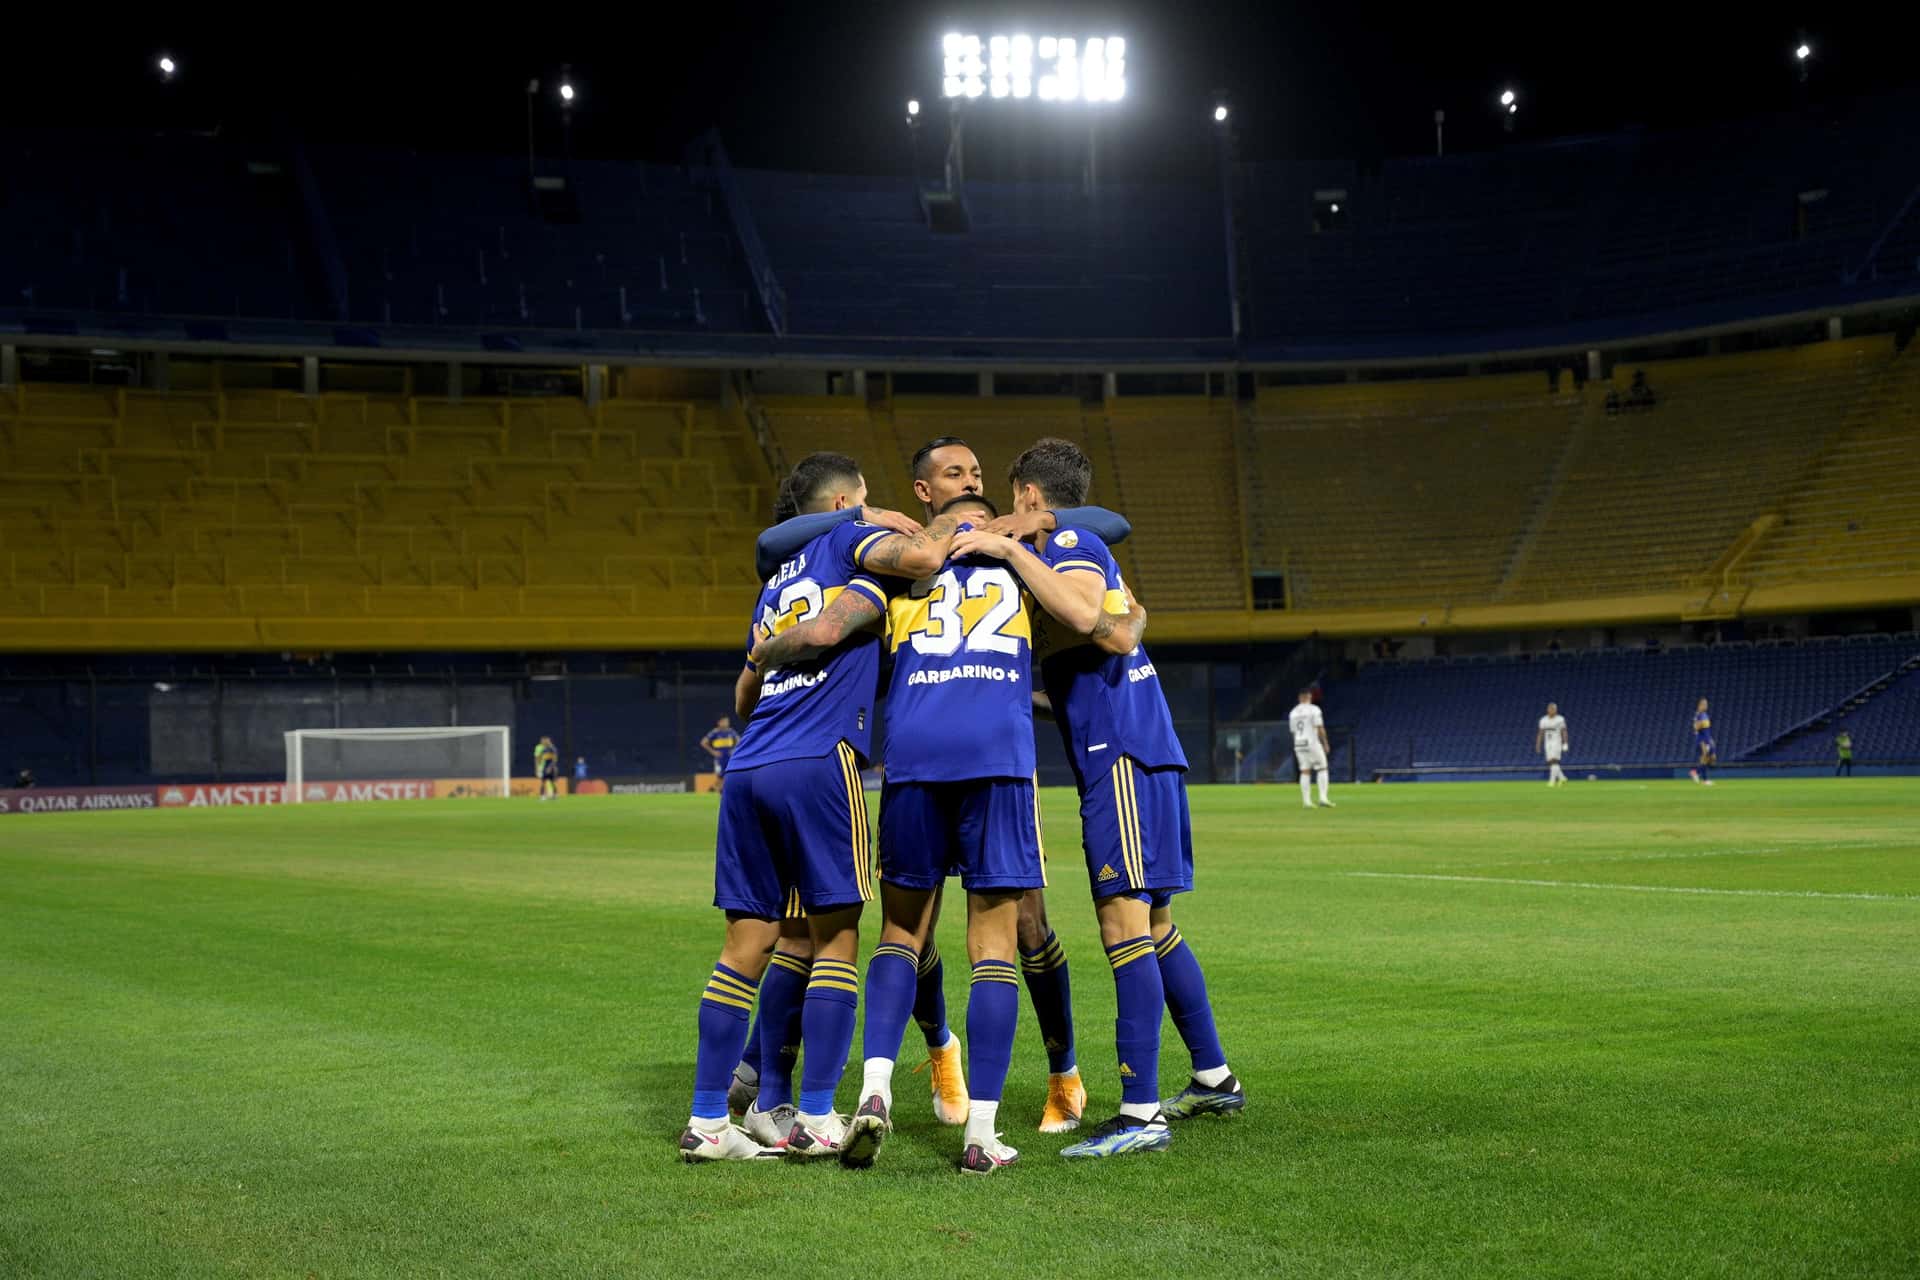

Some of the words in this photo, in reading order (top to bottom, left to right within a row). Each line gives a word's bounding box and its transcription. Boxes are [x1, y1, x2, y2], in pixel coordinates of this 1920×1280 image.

[911, 567, 1020, 657] 32
[333, 782, 430, 801] AMSTEL
[20, 796, 77, 813] QATAR
[84, 792, 153, 809] AIRWAYS
